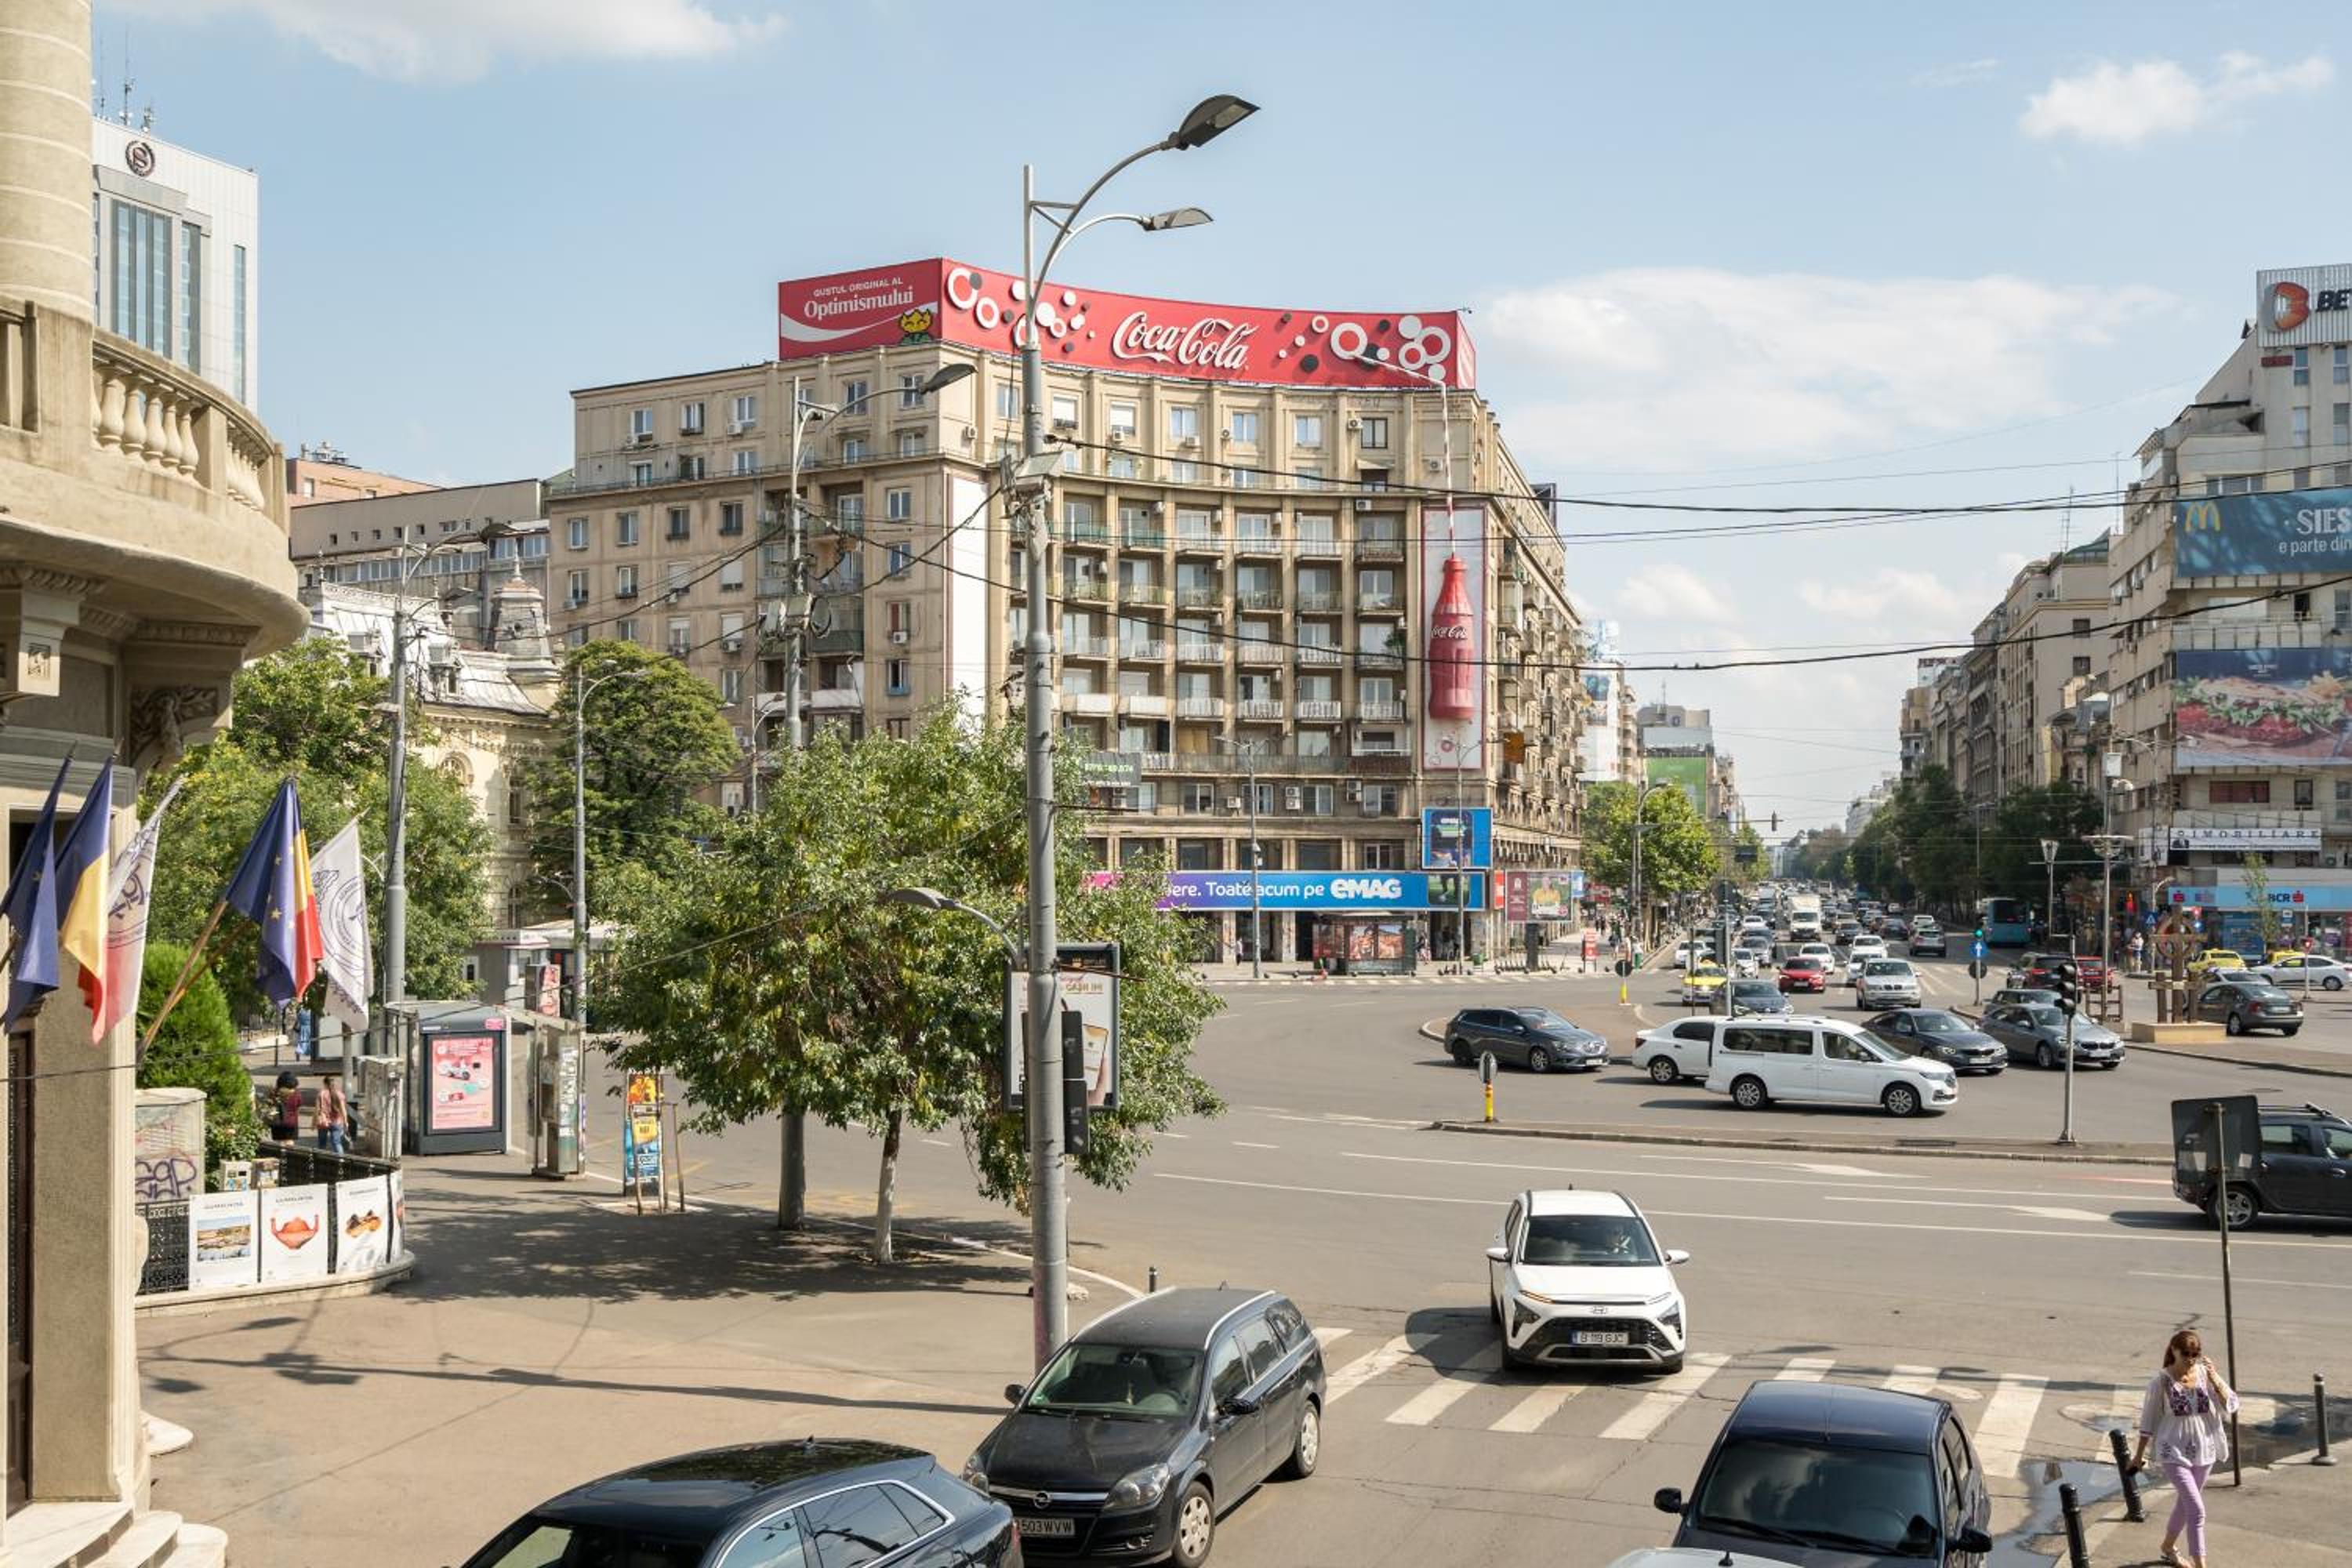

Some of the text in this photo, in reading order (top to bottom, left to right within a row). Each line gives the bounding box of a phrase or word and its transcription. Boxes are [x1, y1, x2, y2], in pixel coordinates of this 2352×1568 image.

[813, 286, 847, 297] GUSTUL
[849, 279, 888, 292] ORIGINAL
[804, 285, 913, 320] Optimismului
[2316, 288, 2352, 312] BE
[1112, 310, 1259, 370] Coca-Cola
[2279, 542, 2288, 553] e
[2290, 540, 2326, 557] parte
[1205, 882, 1252, 896] Toate
[1256, 885, 1300, 896] acum
[1304, 884, 1325, 898] pe
[1330, 878, 1402, 899] eMAG
[2268, 893, 2290, 902] BCR
